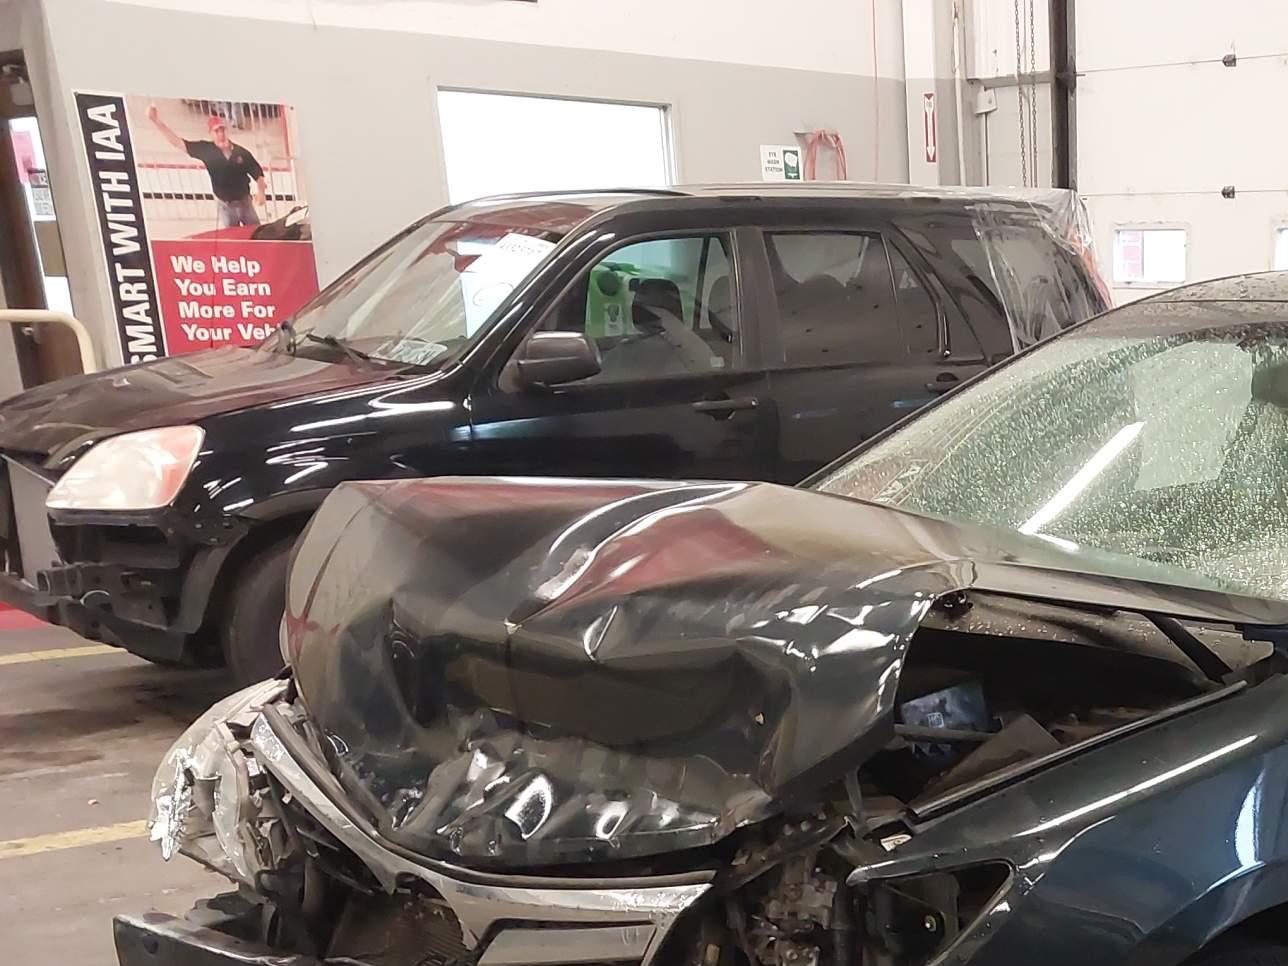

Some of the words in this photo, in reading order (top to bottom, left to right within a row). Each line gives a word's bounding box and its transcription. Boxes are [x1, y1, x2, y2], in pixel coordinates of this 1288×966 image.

[87, 103, 126, 161] IAA
[99, 170, 141, 256] WITH
[170, 255, 205, 273] We
[211, 255, 260, 277] Help
[174, 278, 216, 296] You
[222, 278, 271, 296] Earn
[178, 301, 235, 318] More
[240, 301, 275, 318] For
[181, 323, 232, 341] Your
[237, 323, 280, 340] Veh
